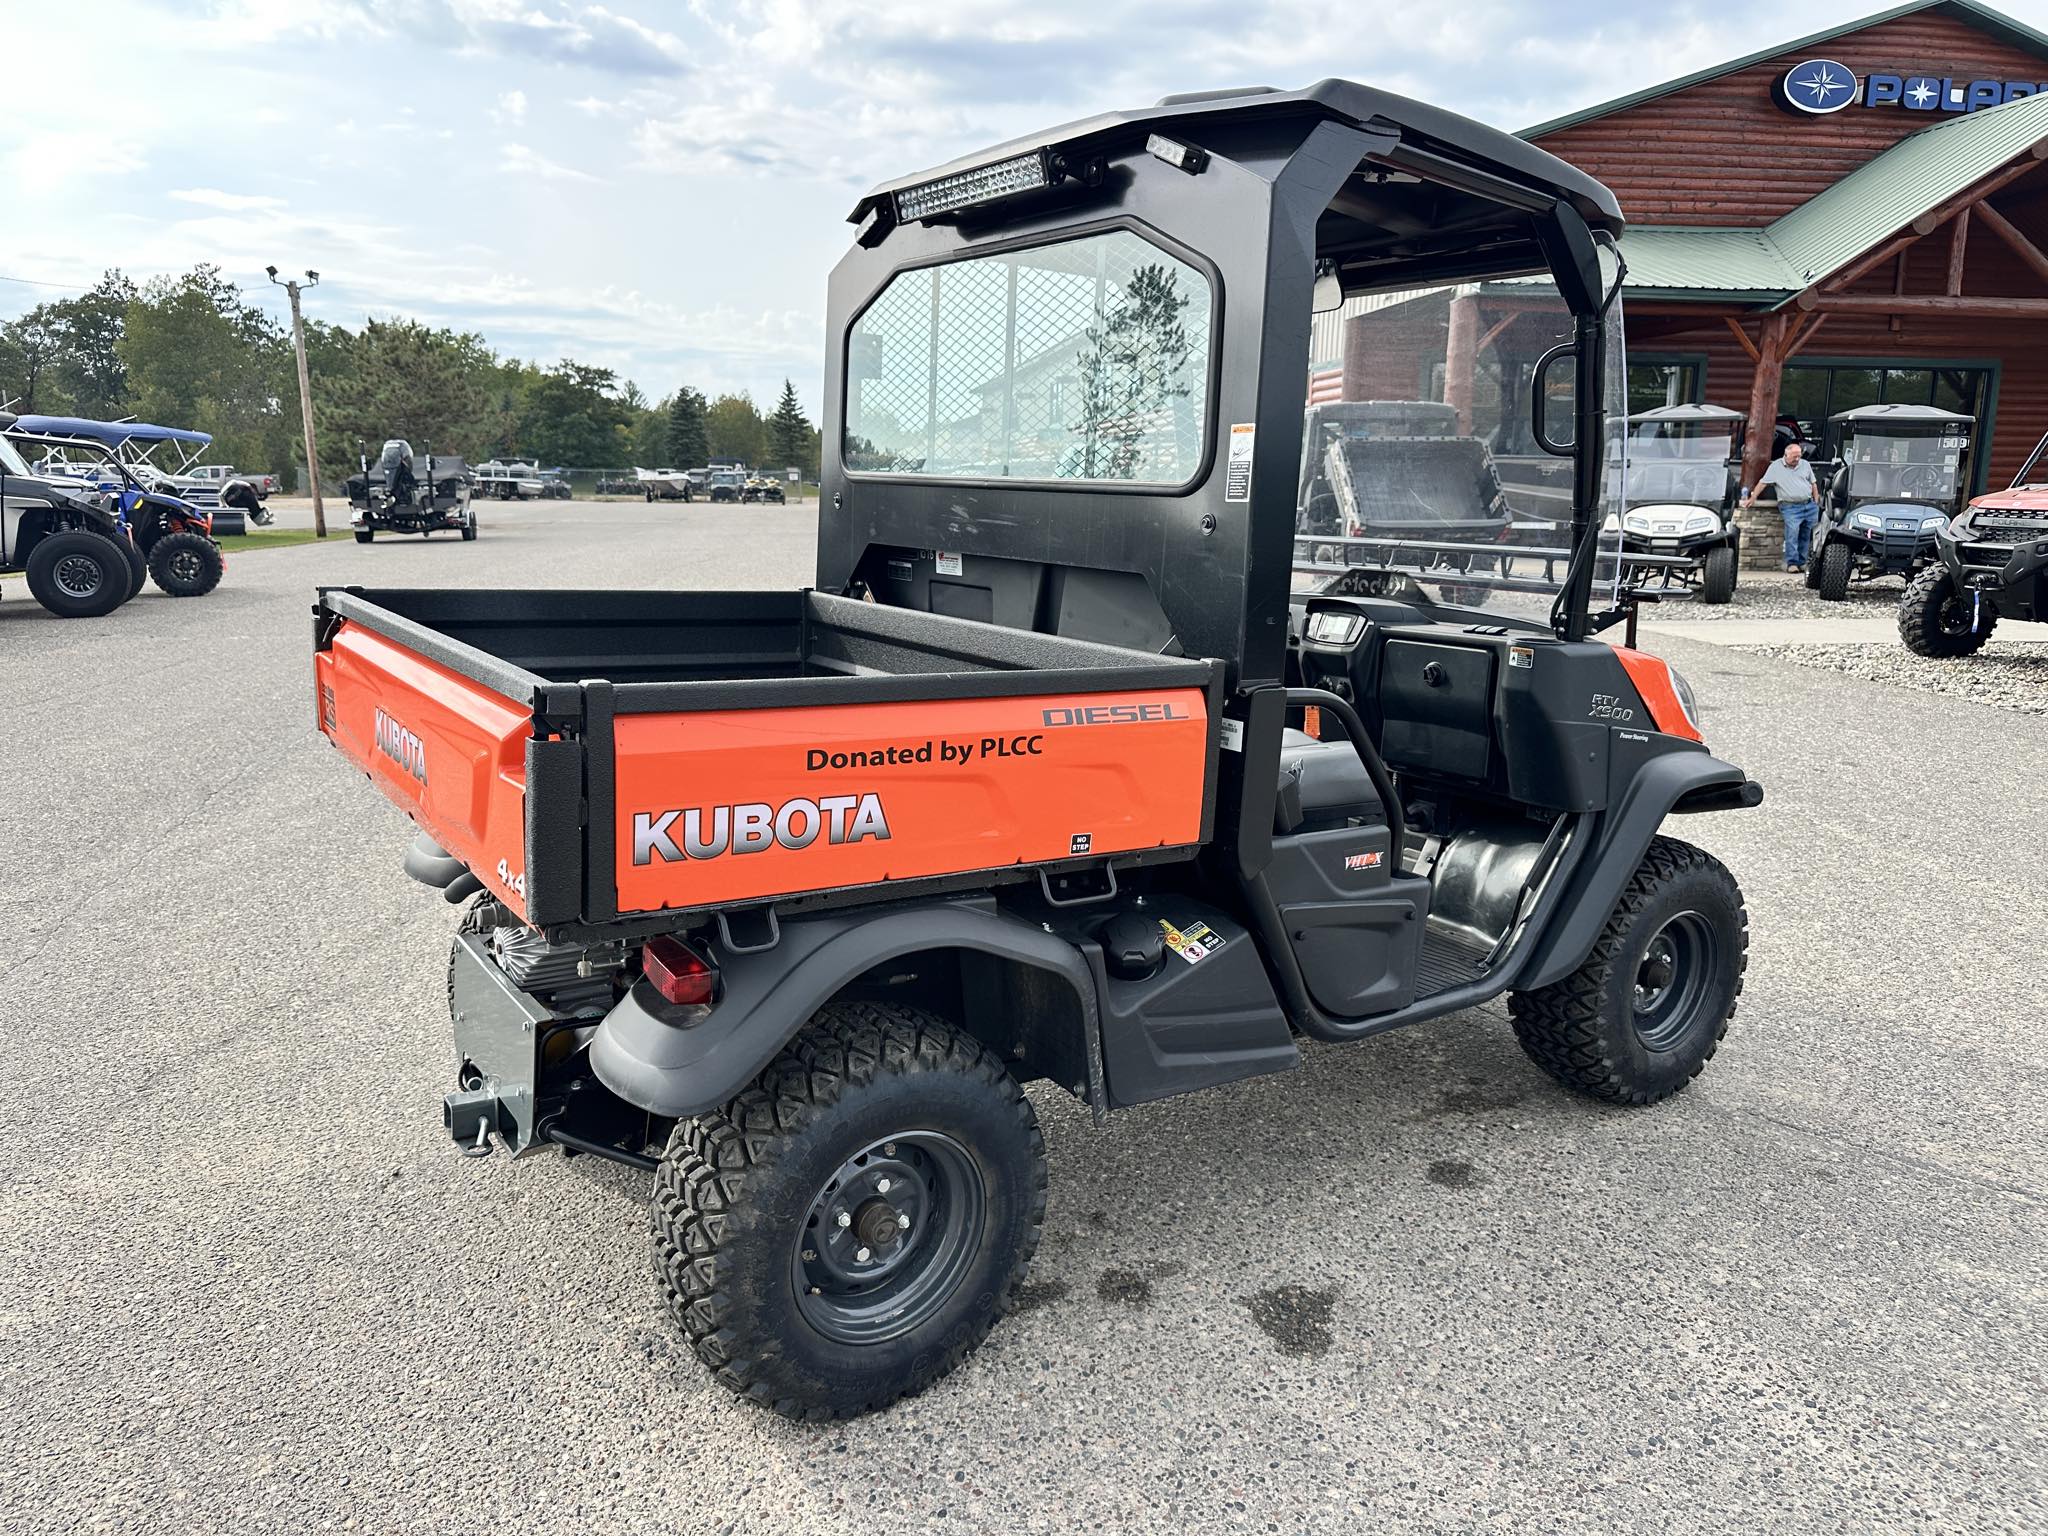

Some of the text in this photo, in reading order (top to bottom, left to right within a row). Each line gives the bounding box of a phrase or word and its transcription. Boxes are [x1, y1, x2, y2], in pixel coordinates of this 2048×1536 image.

[1866, 74, 2048, 112] POLAR
[1592, 693, 1620, 706] RTV
[1042, 703, 1189, 727] DIESEL
[1588, 704, 1633, 721] X900
[375, 705, 427, 787] KUBOTA
[806, 735, 1043, 771] Donated by PLCC
[633, 792, 891, 866] KUBOTA
[1072, 843, 1089, 851] STEP
[1076, 836, 1087, 844] NO
[1203, 935, 1213, 943] NO
[1205, 937, 1219, 949] STEP
